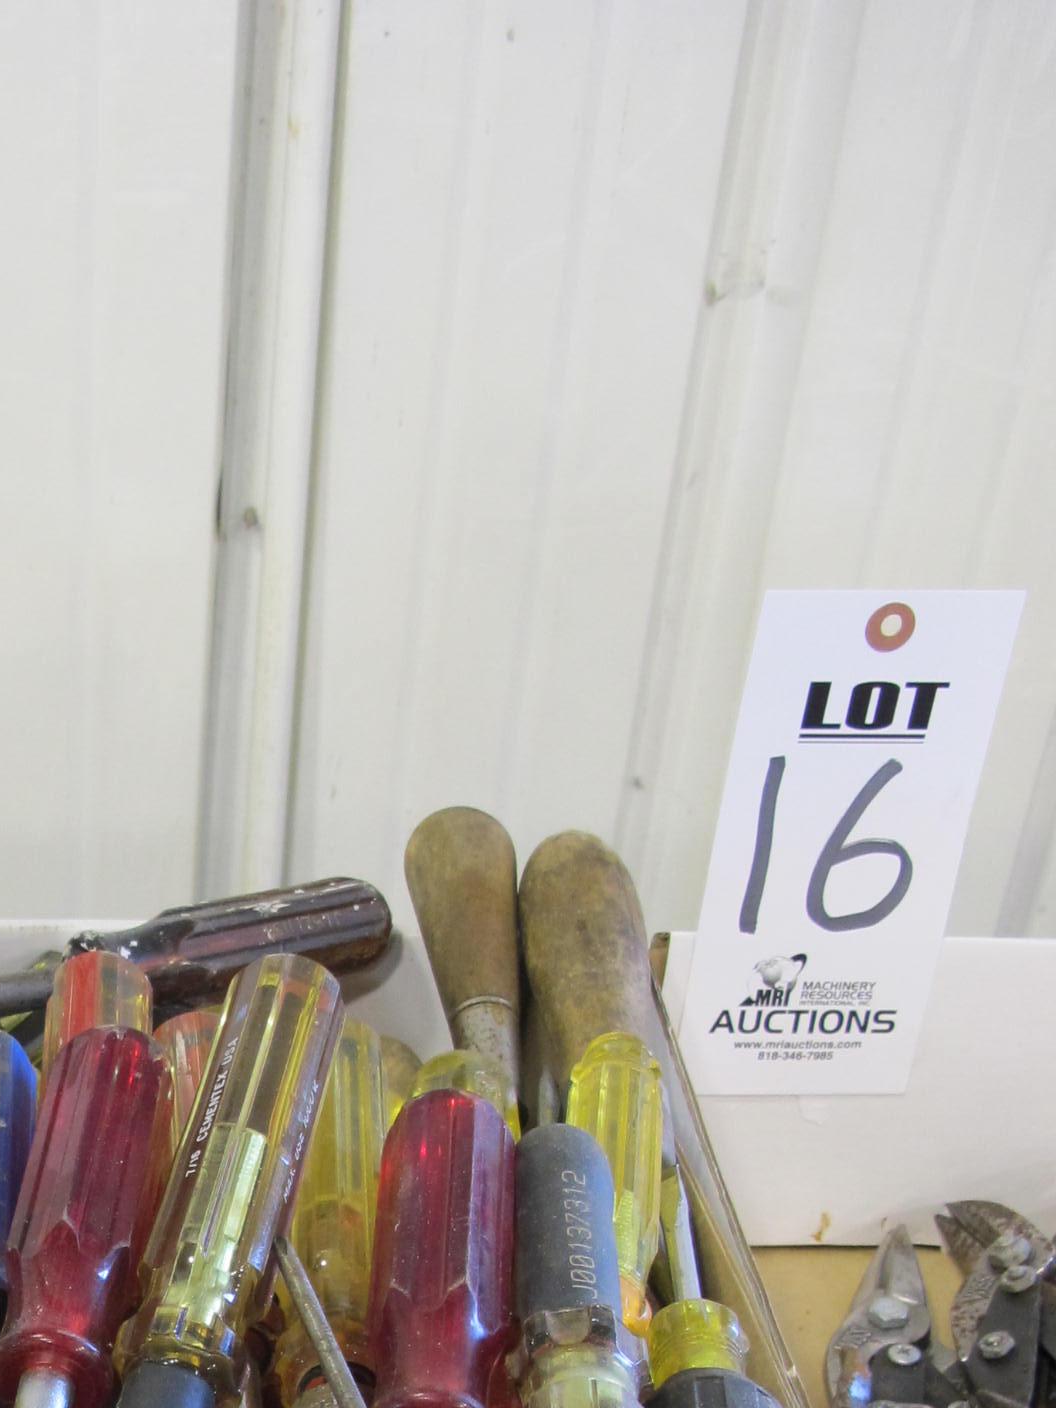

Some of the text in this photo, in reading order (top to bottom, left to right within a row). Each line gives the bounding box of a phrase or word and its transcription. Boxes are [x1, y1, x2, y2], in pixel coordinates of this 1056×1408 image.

[800, 681, 951, 731] LOT
[739, 755, 914, 935] 16
[802, 981, 876, 991] MACHINERY
[800, 991, 873, 1001] RESOURCES
[709, 1009, 898, 1035] AUCTIONS
[734, 1040, 862, 1050] www.mriauctions.com
[757, 1051, 834, 1062] 818-346-7985
[196, 1068, 228, 1143] CEMENTEX
